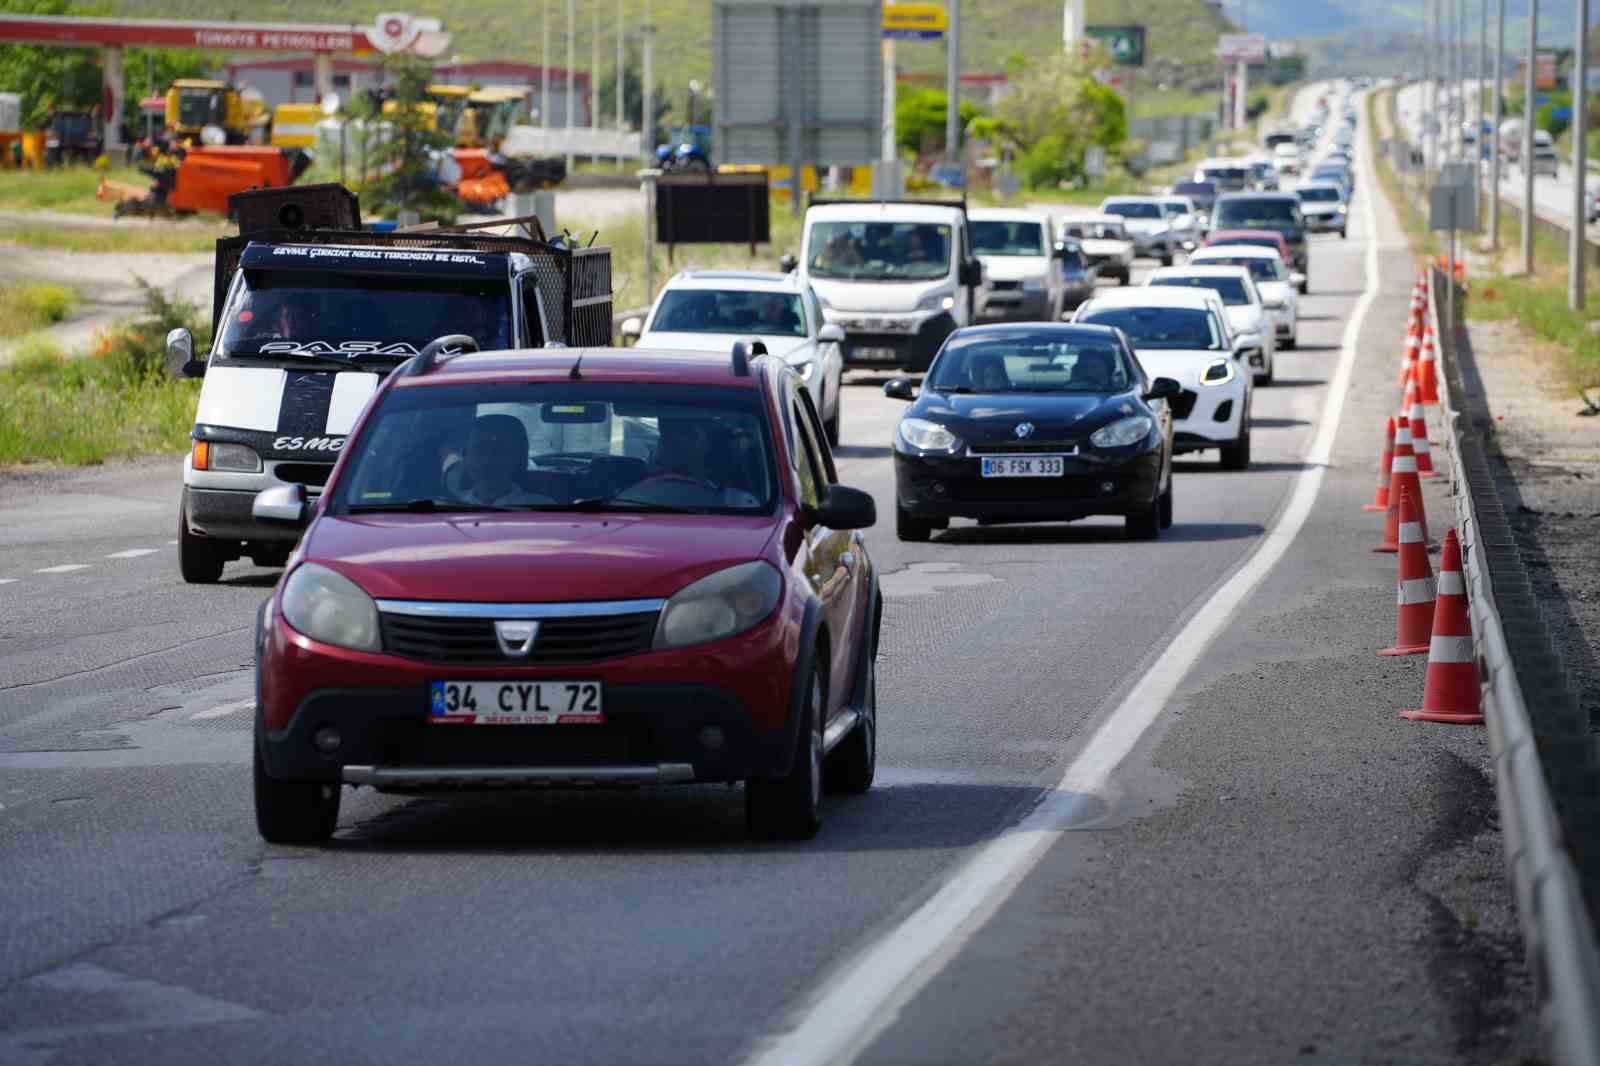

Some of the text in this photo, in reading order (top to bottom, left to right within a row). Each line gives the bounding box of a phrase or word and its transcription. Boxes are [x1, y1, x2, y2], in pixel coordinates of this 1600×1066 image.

[991, 460, 1004, 474] 06
[1039, 460, 1061, 474] 333
[447, 684, 598, 711] 34 CYL 72
